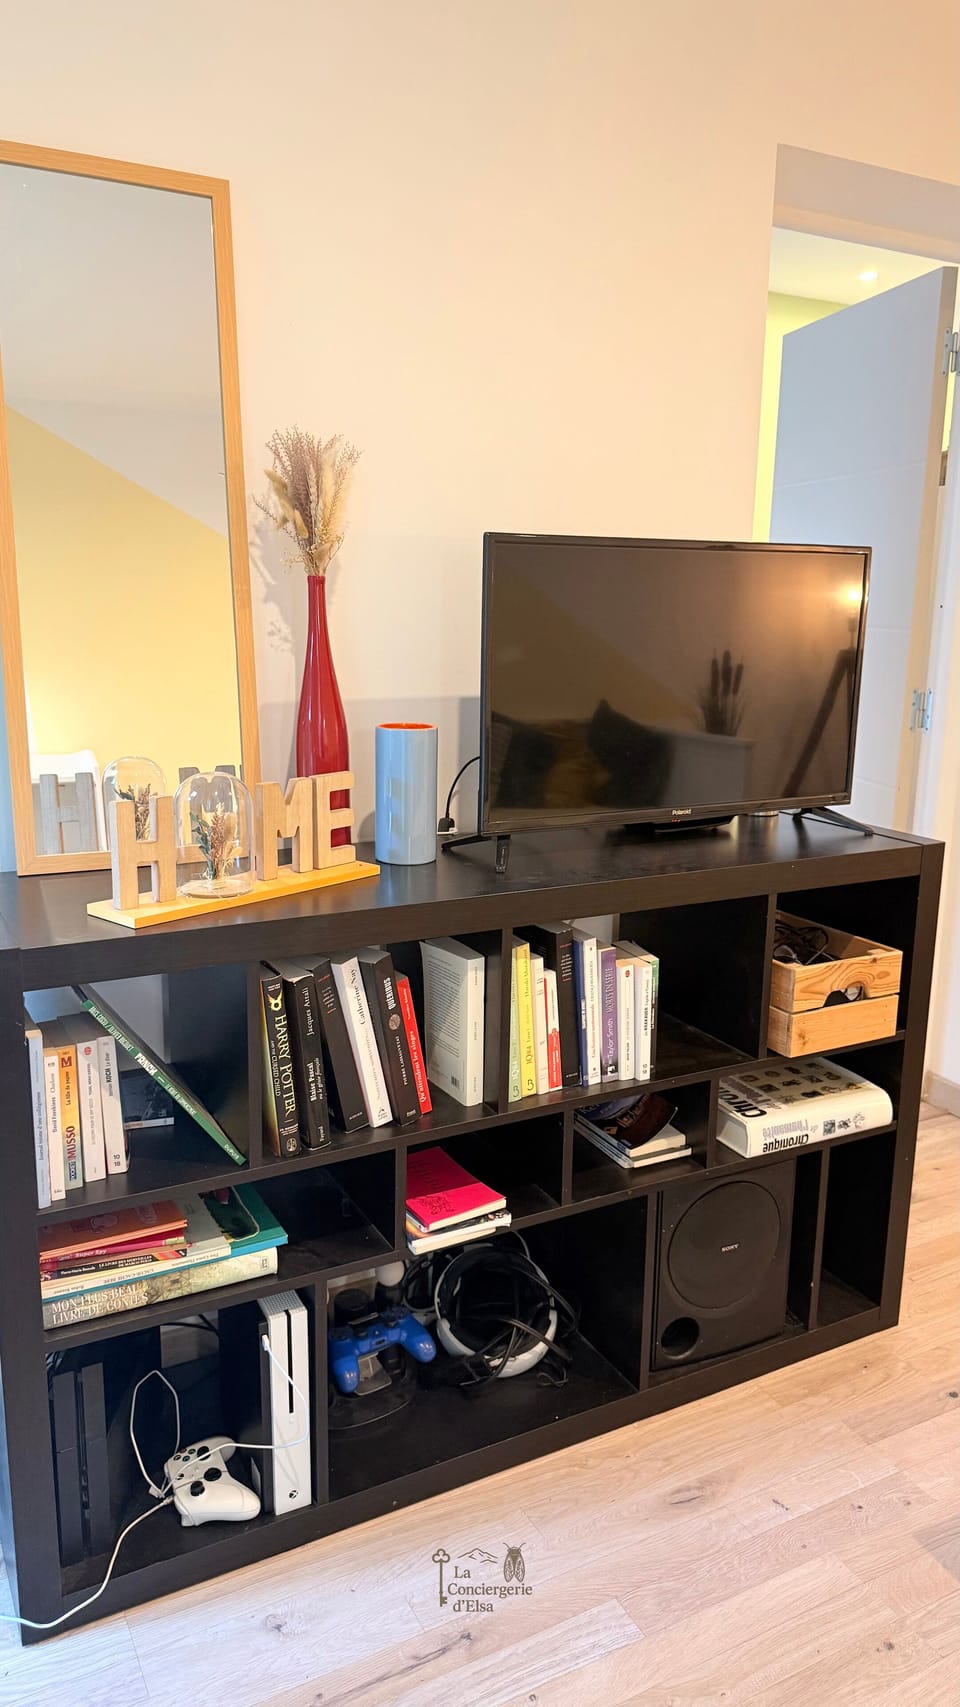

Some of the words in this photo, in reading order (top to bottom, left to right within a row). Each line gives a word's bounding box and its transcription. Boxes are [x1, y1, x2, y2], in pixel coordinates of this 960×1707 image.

[109, 771, 357, 911] HME
[352, 985, 366, 1025] Catherine
[275, 1013, 290, 1060] HARRY
[306, 1008, 315, 1036] Jacques
[409, 1031, 418, 1051] singes
[280, 1063, 296, 1117] POTTER
[413, 1060, 426, 1103] Qu'attendent
[66, 1125, 76, 1159] MUSSO
[763, 1133, 809, 1153] Chronique
[75, 1249, 94, 1259] Super
[95, 1248, 107, 1256] Spy
[721, 1243, 740, 1252] SONY
[52, 1299, 77, 1313] MON
[80, 1292, 108, 1307] PLUS
[52, 1310, 82, 1324] LIVRE
[88, 1303, 104, 1315] DE
[108, 1291, 149, 1310] CONTES
